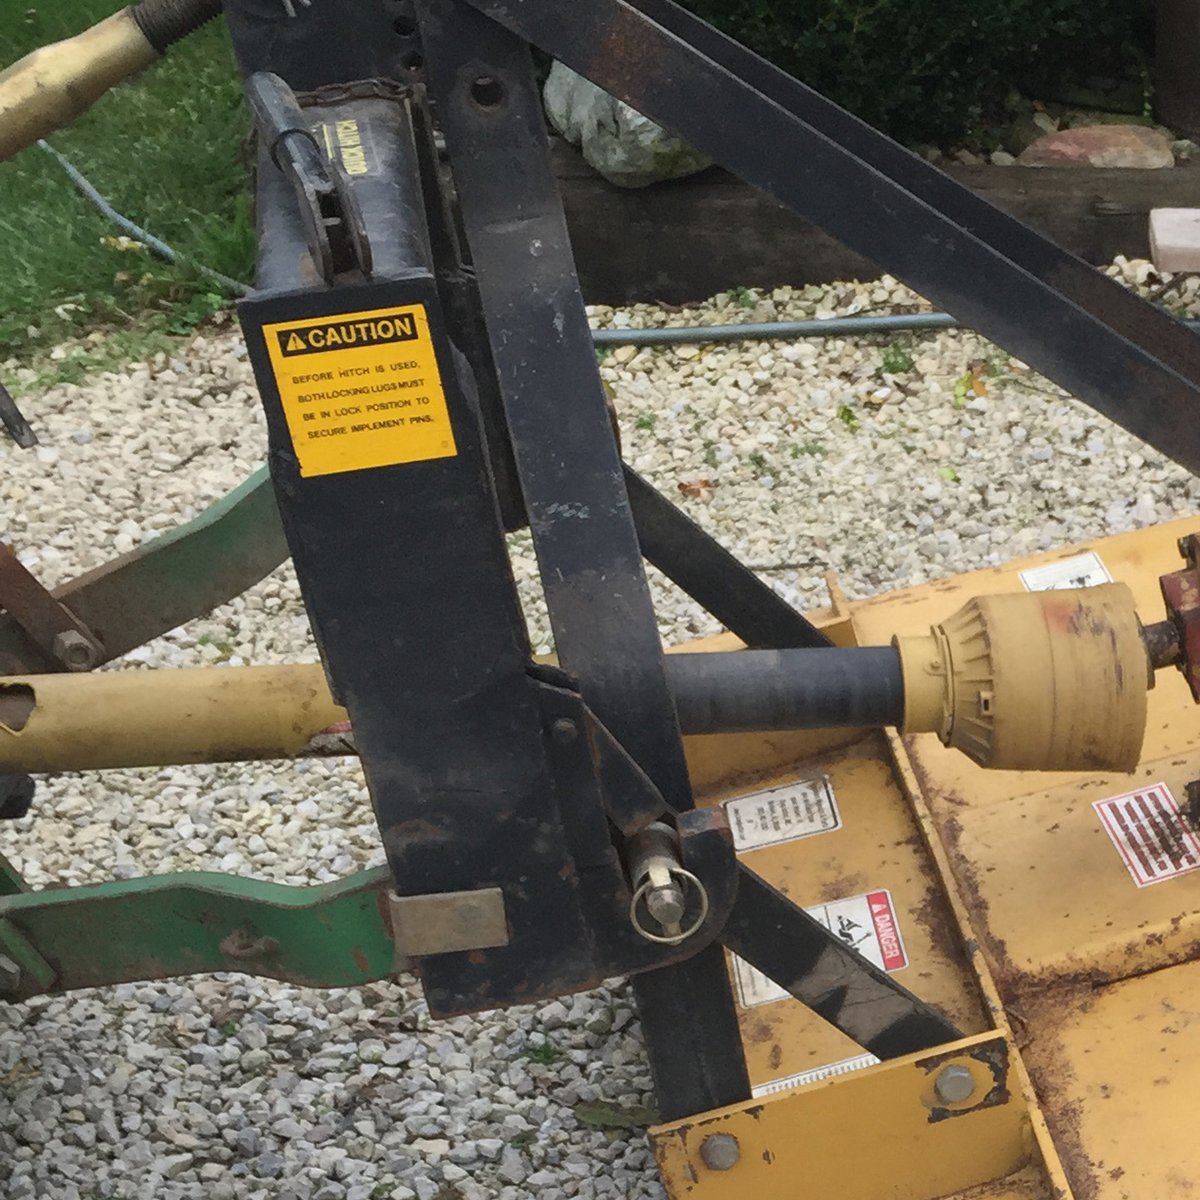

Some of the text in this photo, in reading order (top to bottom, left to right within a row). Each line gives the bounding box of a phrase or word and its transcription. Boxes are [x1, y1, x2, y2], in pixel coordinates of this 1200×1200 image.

[308, 317, 412, 347] CAUTION
[292, 371, 334, 384] BEFORE
[339, 366, 370, 379] HITCH
[376, 364, 385, 374] IS
[303, 396, 430, 422] BE IN LOCK POSITION TO
[308, 426, 348, 439] SECURE
[351, 418, 406, 433] IMPLEMENT
[874, 912, 900, 960] DANGER
